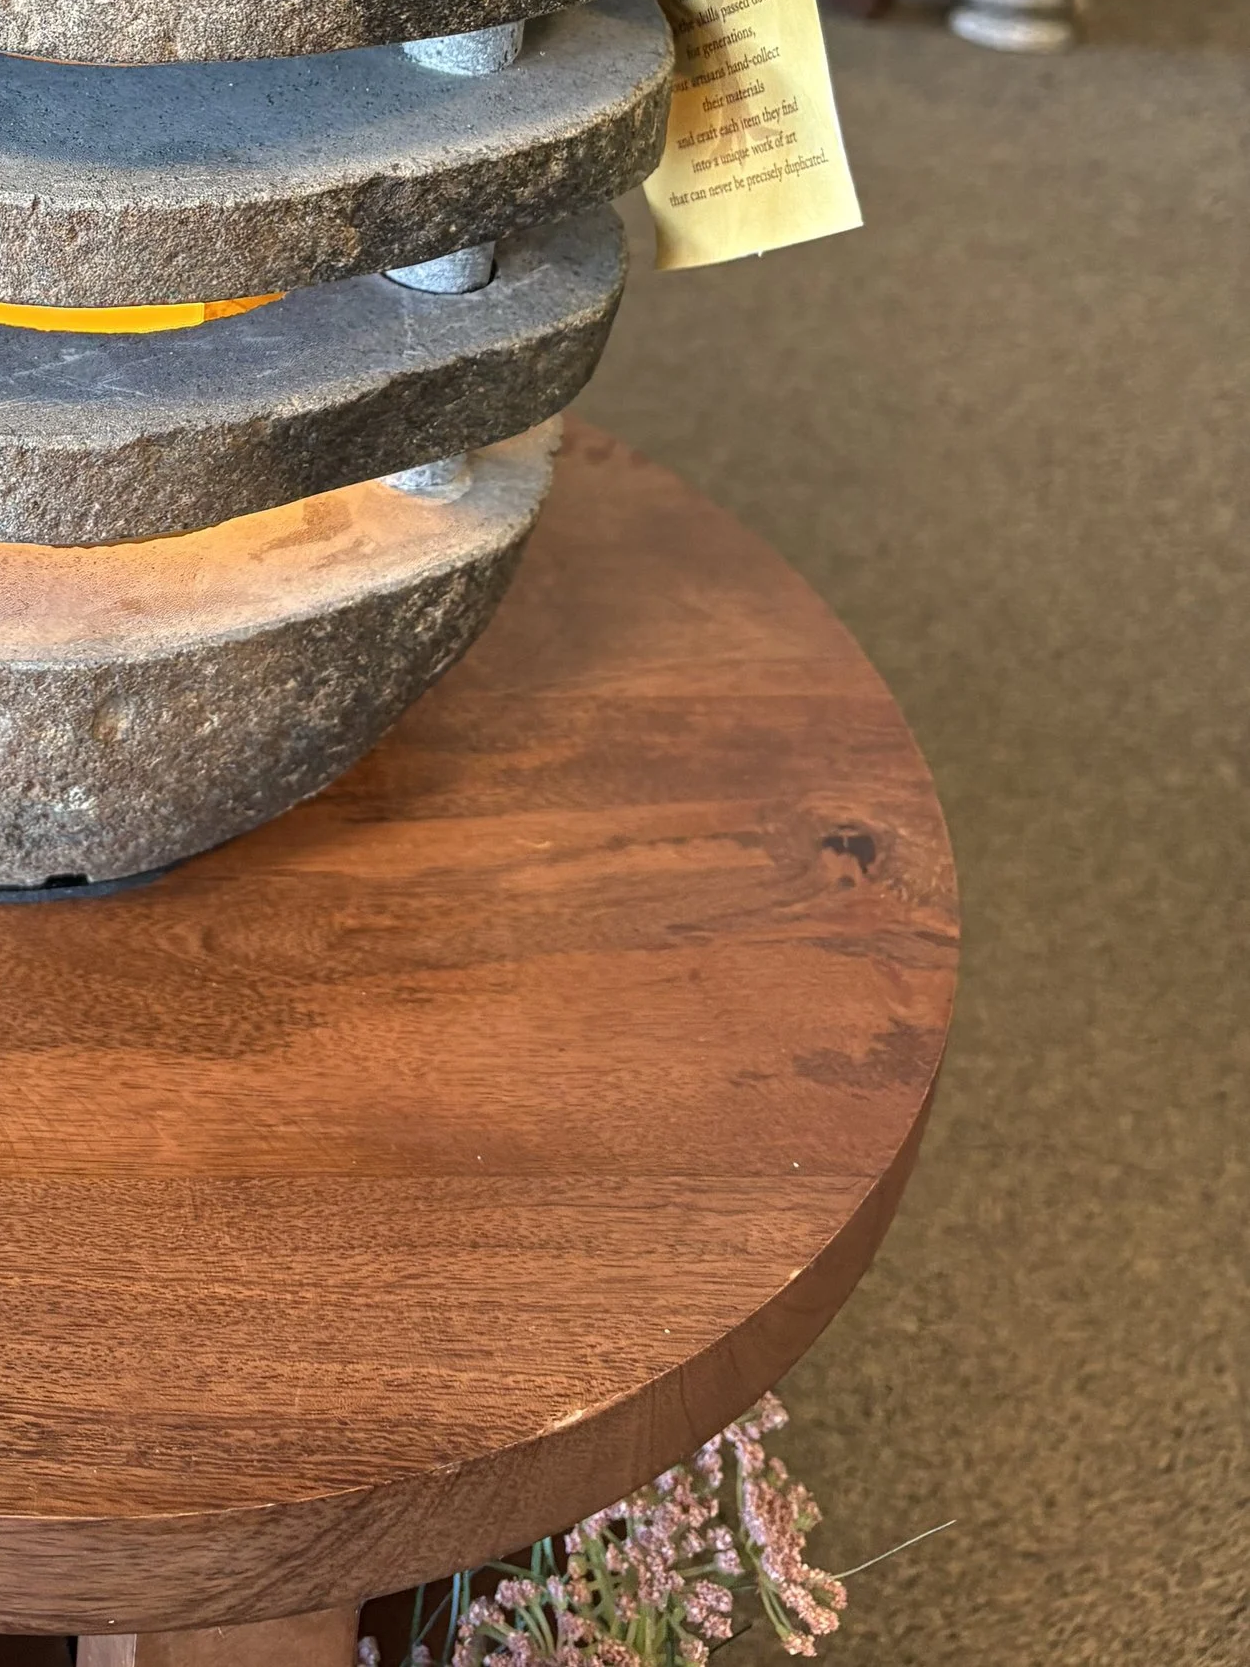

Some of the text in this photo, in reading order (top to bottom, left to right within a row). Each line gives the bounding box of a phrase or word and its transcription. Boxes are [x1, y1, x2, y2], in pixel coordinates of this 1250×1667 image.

[697, 7, 719, 27] skills
[702, 26, 756, 59] generations,
[691, 67, 725, 87] artisans
[726, 46, 780, 75] hand-collect
[703, 79, 765, 112] their materials
[677, 96, 799, 149] and craft each item they find
[691, 130, 798, 173] into a unique work of art
[669, 148, 829, 207] that can never be precisely duplicated.
